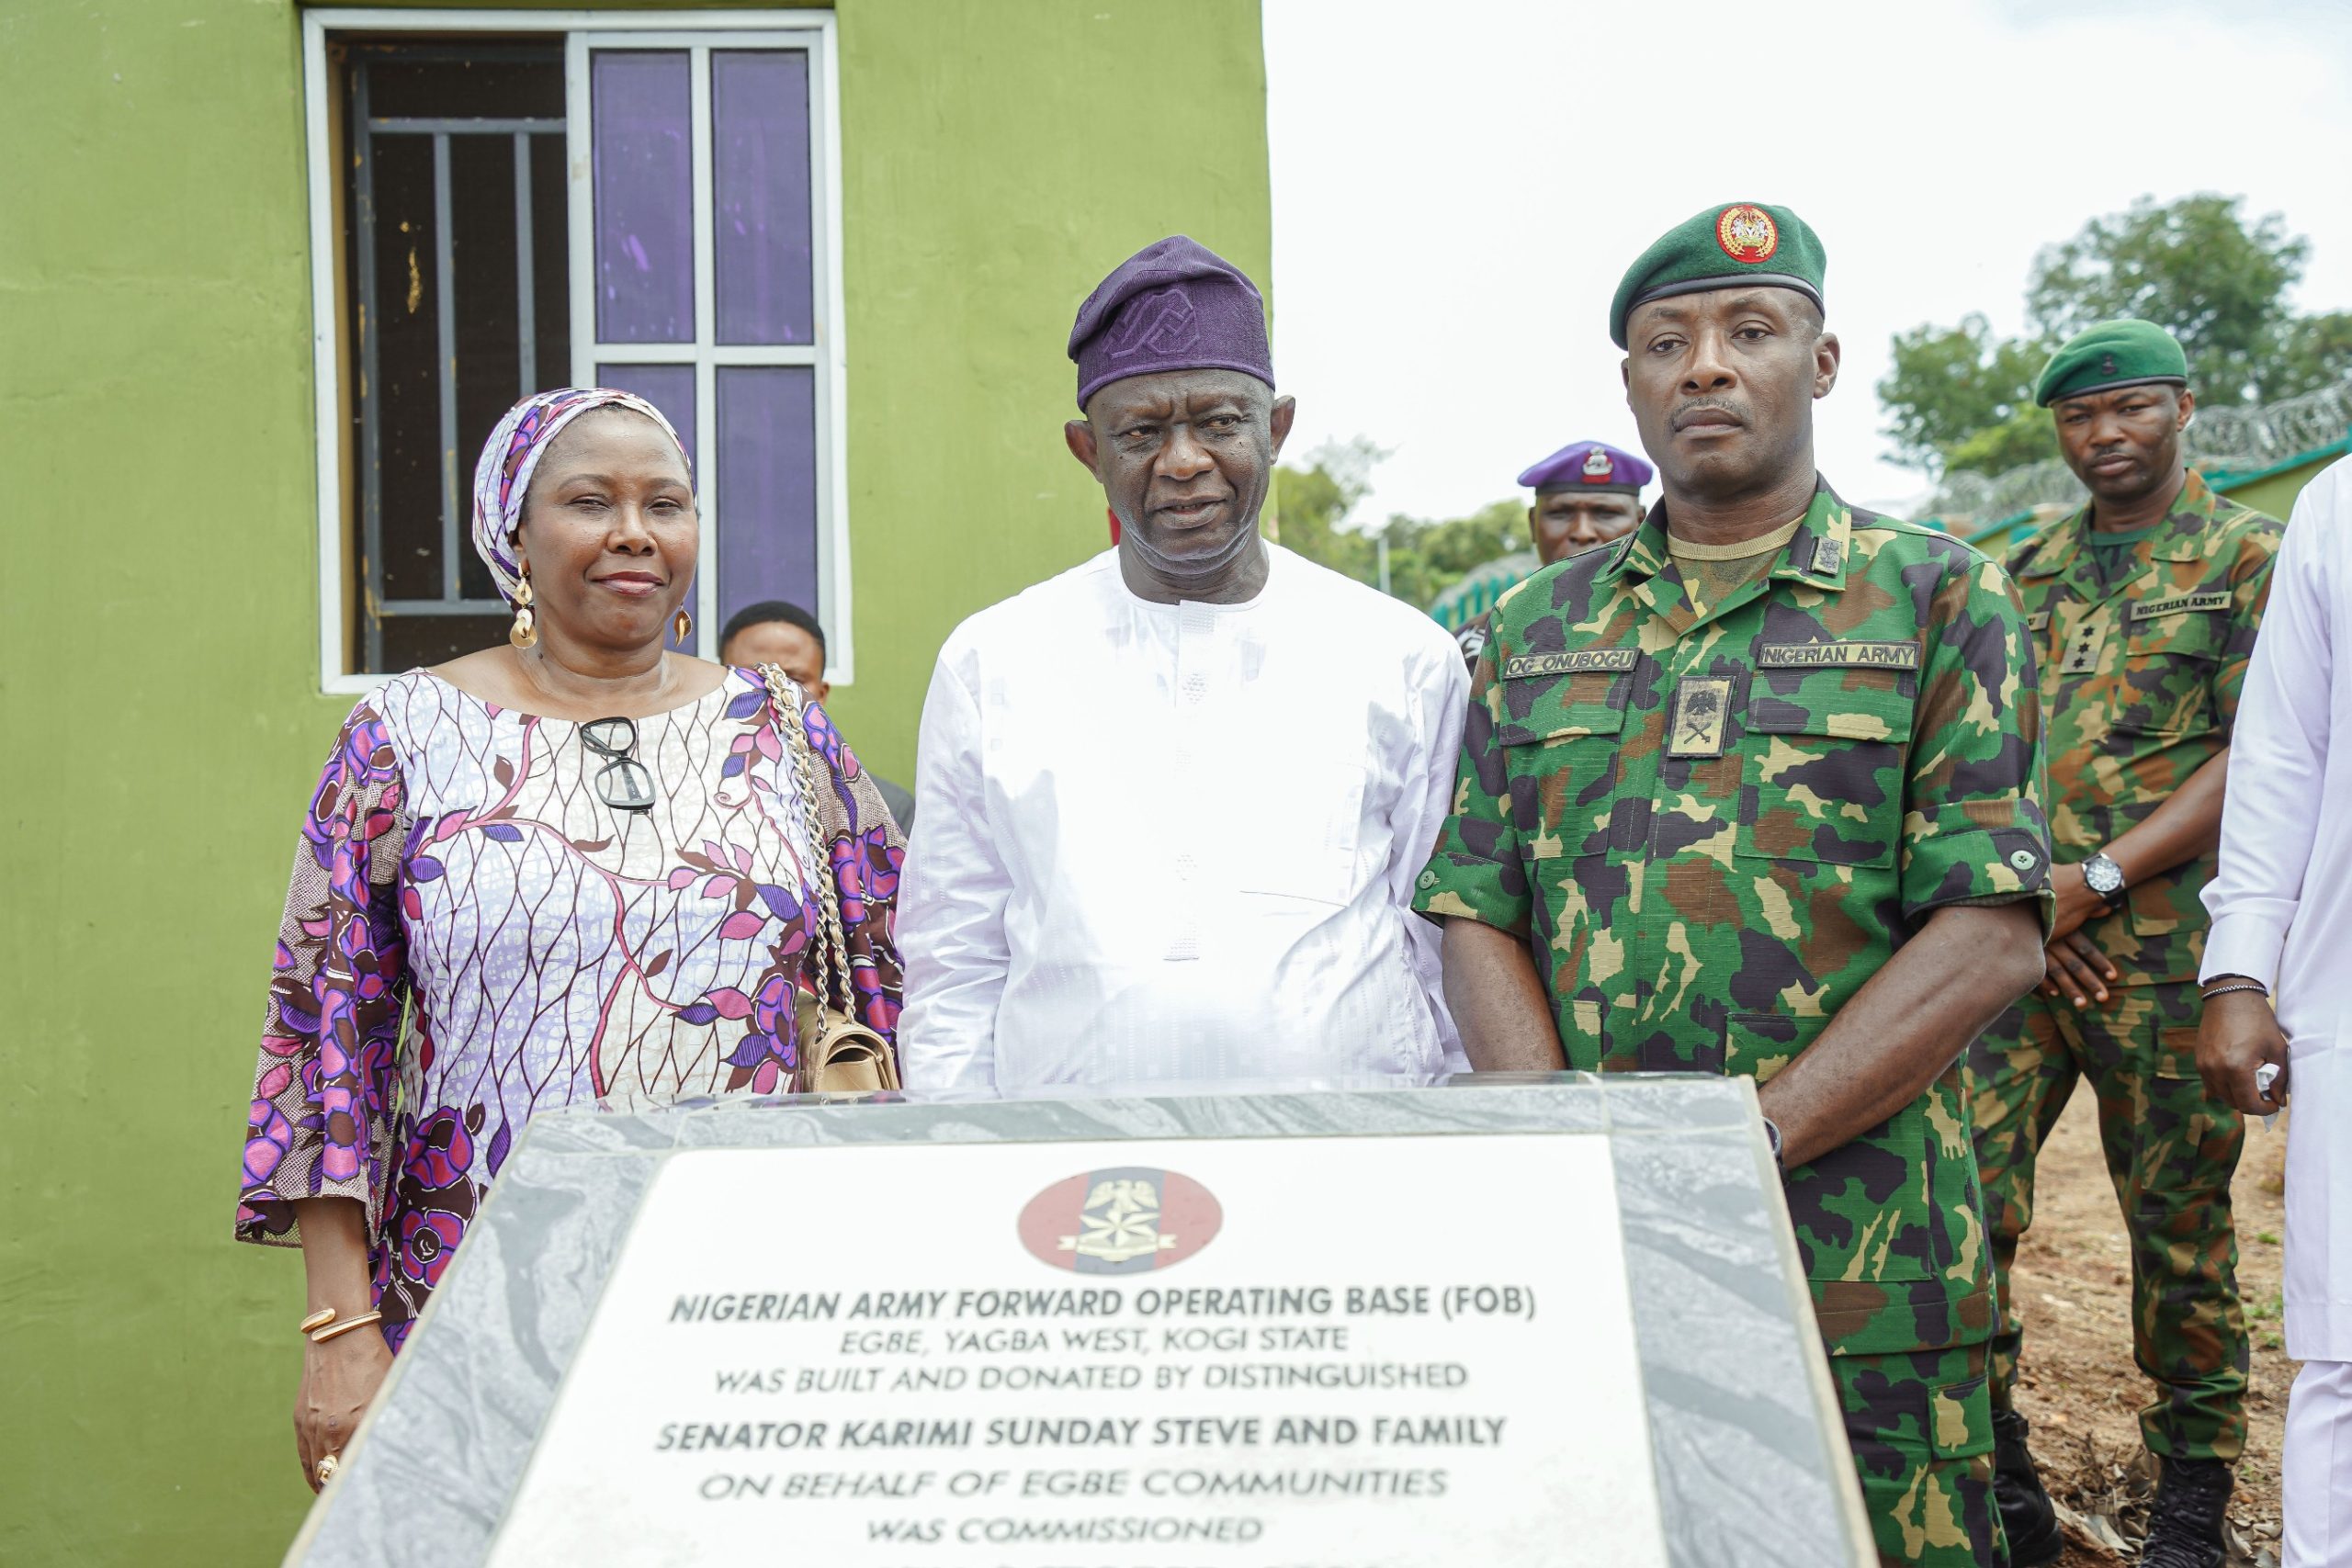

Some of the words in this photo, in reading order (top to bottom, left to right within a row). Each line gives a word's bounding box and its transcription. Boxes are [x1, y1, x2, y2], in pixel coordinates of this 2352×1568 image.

[2136, 598, 2188, 615] NIGERIAN
[2190, 596, 2225, 606] ARMY
[1509, 658, 1535, 673] OG
[1543, 650, 1634, 670] ONUBOGU
[1763, 646, 1849, 663] NIGERIAN
[1857, 646, 1914, 664] ARMY
[668, 1292, 842, 1324] NIGERIAN
[846, 1290, 949, 1320] ARMY
[954, 1288, 1122, 1319] FORWARD
[1136, 1286, 1334, 1317] OPERATING
[1344, 1285, 1430, 1316] BASE
[1441, 1284, 1536, 1323] (FOB)
[839, 1331, 928, 1357] EGBE,
[946, 1330, 1048, 1352] YAGBA
[1062, 1328, 1148, 1355] WEST,
[1163, 1328, 1248, 1351] KOGI
[1261, 1326, 1347, 1351] STATE
[716, 1368, 786, 1394] WAS
[795, 1367, 884, 1393] BUILT
[890, 1366, 968, 1392] AND
[978, 1365, 1142, 1391] DONATED
[1155, 1365, 1193, 1390] BY
[1204, 1362, 1469, 1389] DISTINGUISHED
[654, 1420, 830, 1452] SENATOR
[837, 1418, 975, 1450] KARIMI
[984, 1417, 1142, 1448] SUNDAY
[1151, 1416, 1261, 1446] STEVE
[1272, 1416, 1361, 1446] AND
[1372, 1416, 1508, 1448] FAMILY
[697, 1473, 774, 1501] ON
[781, 1472, 936, 1499] BEHALF
[946, 1470, 1010, 1497] OF
[1020, 1470, 1129, 1497] EGBE
[1141, 1469, 1448, 1497] COMMUNITIES
[867, 1518, 945, 1544] WAS
[956, 1517, 1264, 1544] COMMISSIONED
